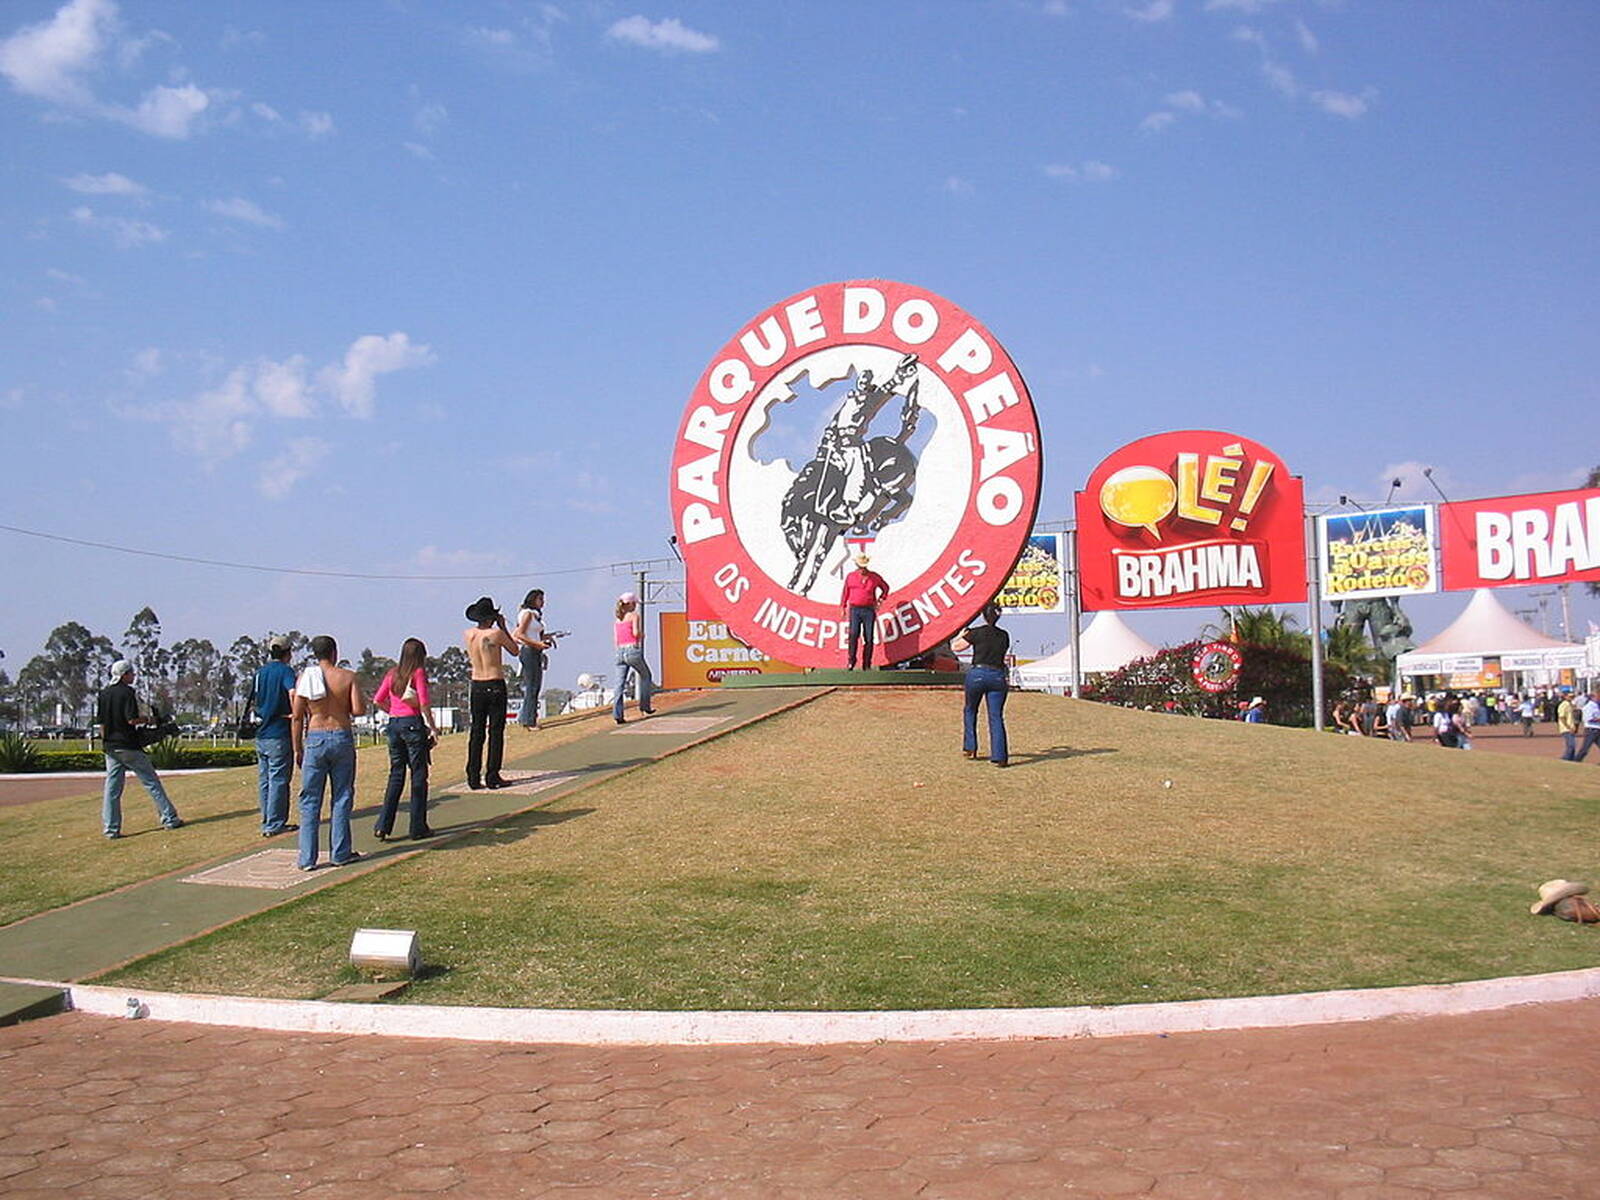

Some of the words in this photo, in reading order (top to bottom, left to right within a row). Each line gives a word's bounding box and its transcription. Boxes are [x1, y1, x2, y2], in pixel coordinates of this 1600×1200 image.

[677, 296, 827, 544] PARQUE
[843, 287, 939, 344] DO
[937, 328, 1035, 526] PEÃO
[1328, 537, 1413, 556] Barretos
[714, 562, 751, 604] OS
[1118, 544, 1262, 598] BRAHMA
[1326, 569, 1408, 594] Rodeio
